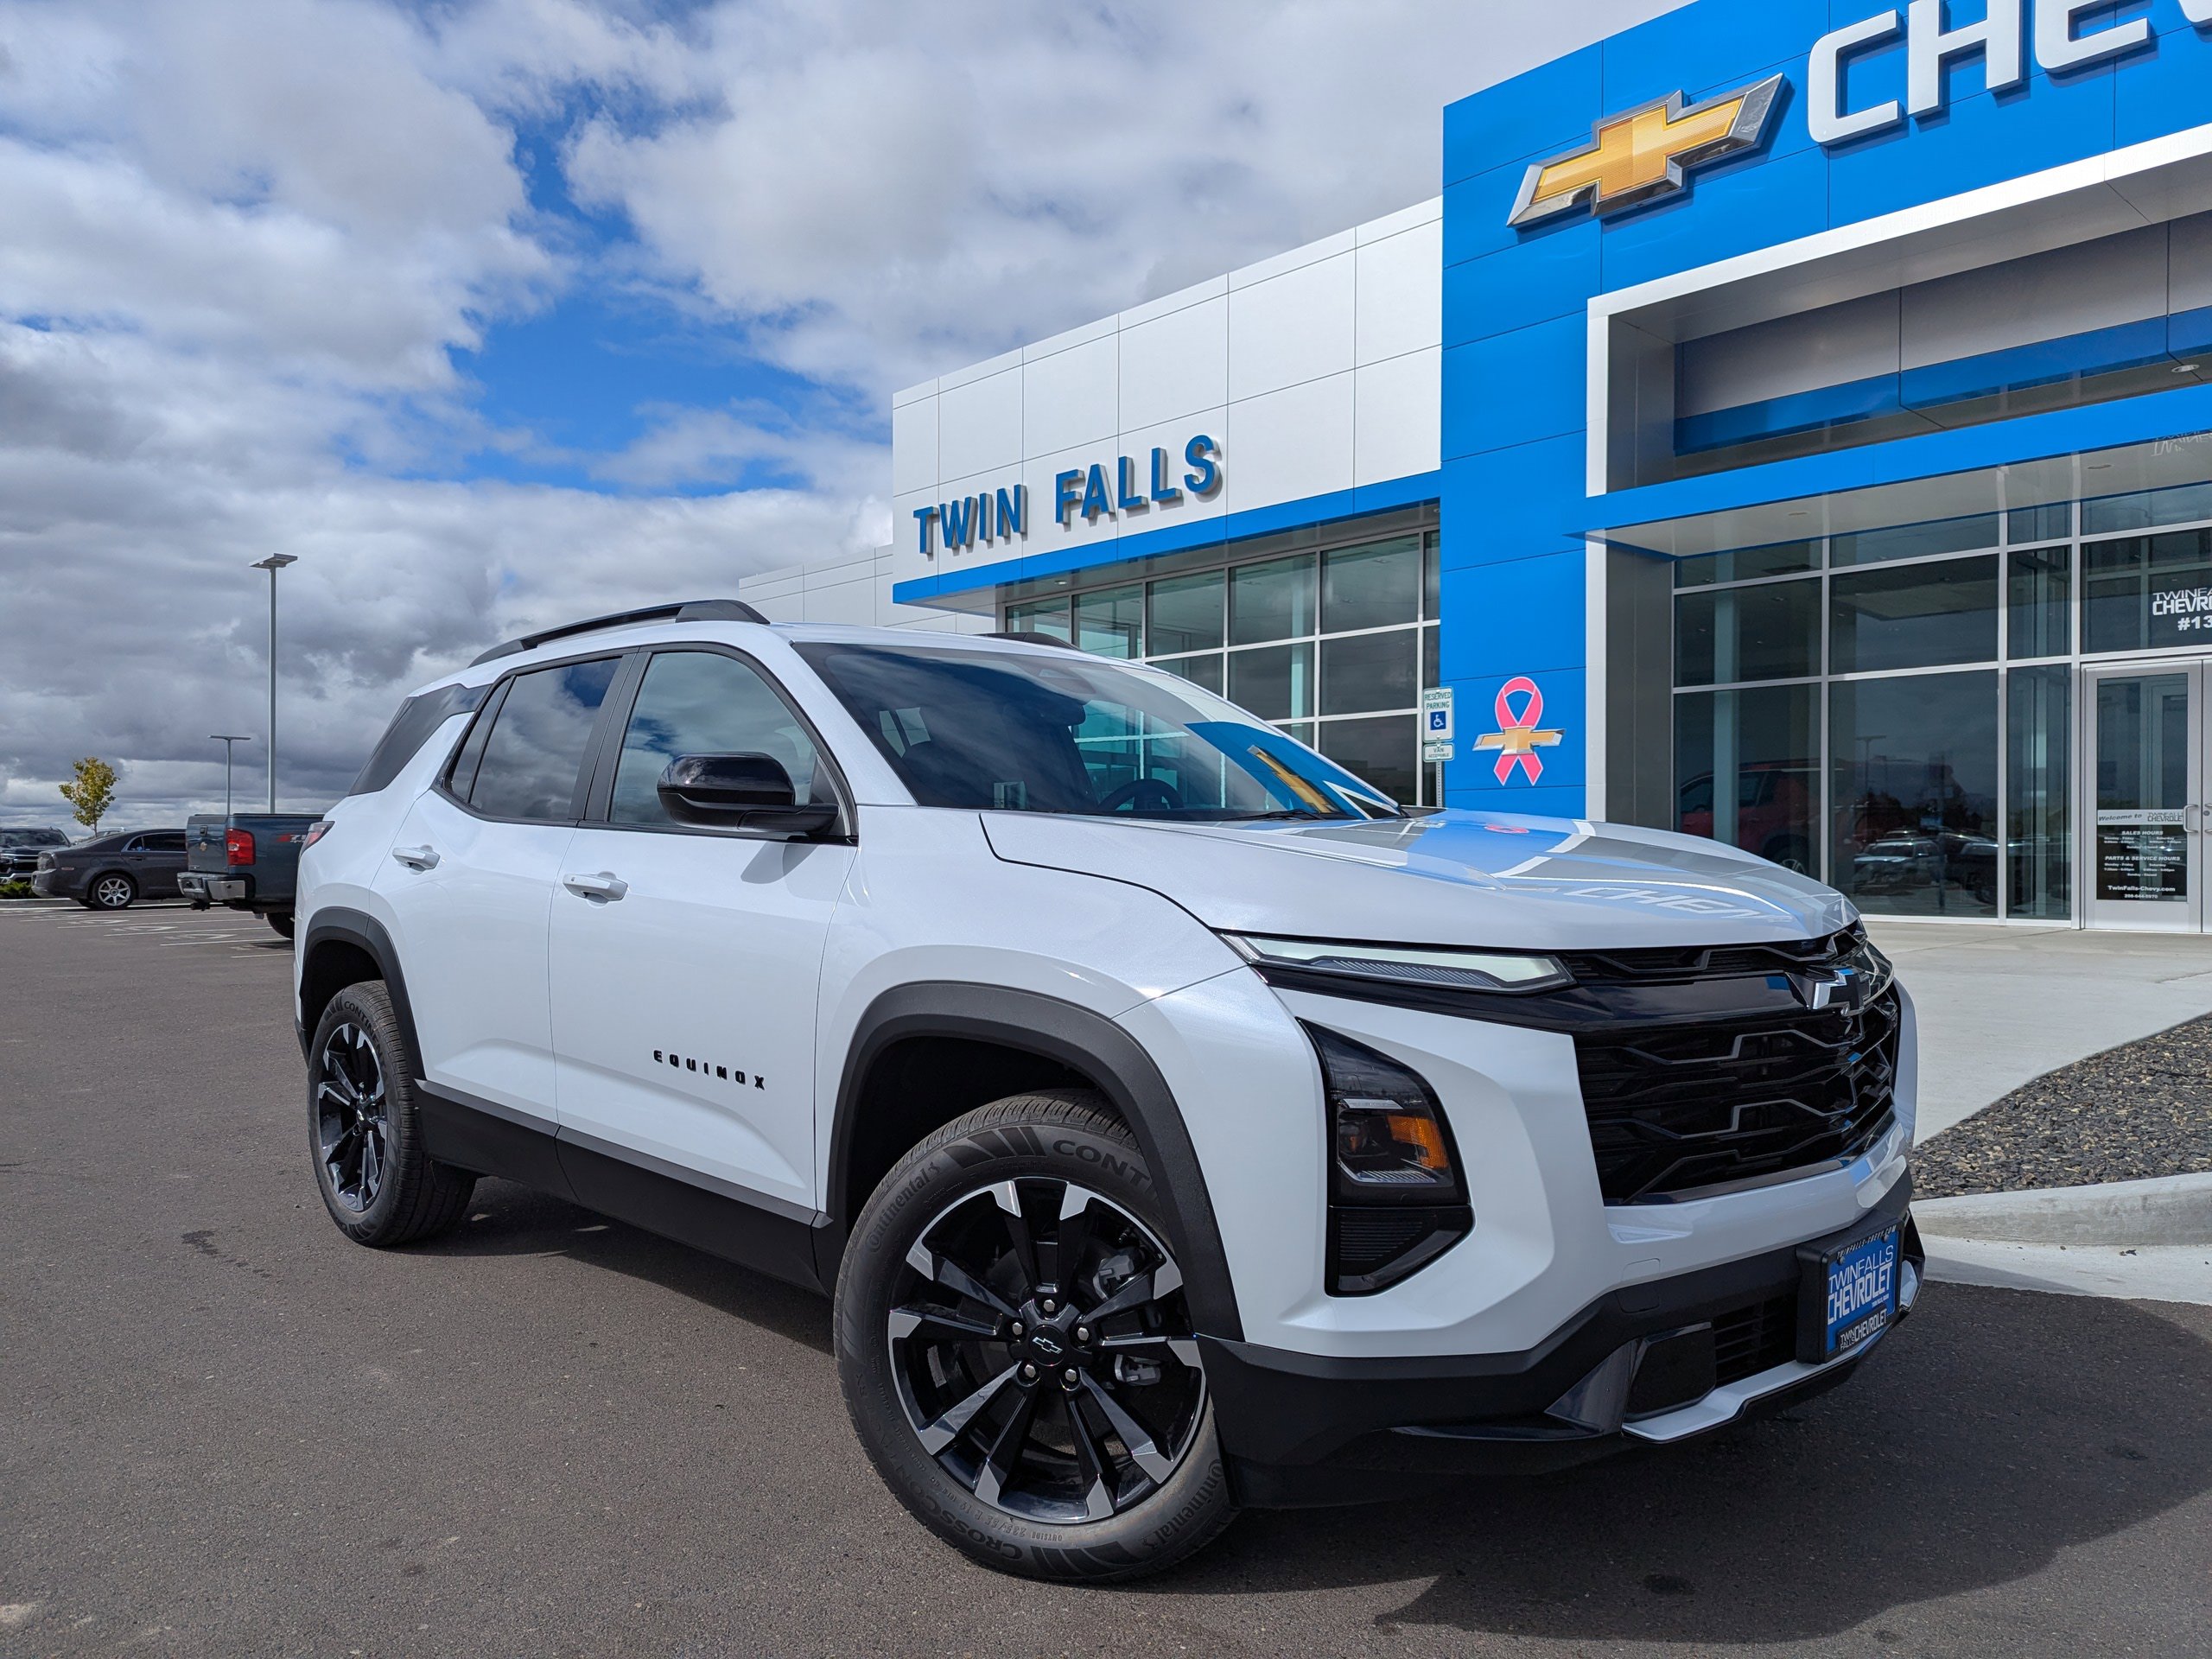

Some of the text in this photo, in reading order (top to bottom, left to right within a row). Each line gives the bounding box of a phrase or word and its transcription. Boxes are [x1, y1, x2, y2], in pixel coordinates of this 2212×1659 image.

[1808, 0, 2212, 143] CHE
[913, 435, 1220, 554] TWIN FALLS
[1424, 692, 1452, 701] RESERVED
[653, 1050, 766, 1090] EQUINOX
[866, 1168, 931, 1251] Continental
[1828, 1245, 1894, 1294] TWINFALLS
[1827, 1262, 1893, 1325] CHEVROLET
[1840, 1328, 1855, 1345] TWIN
[1840, 1336, 1855, 1351] FALLS
[1854, 1308, 1888, 1342] CHEVROLET
